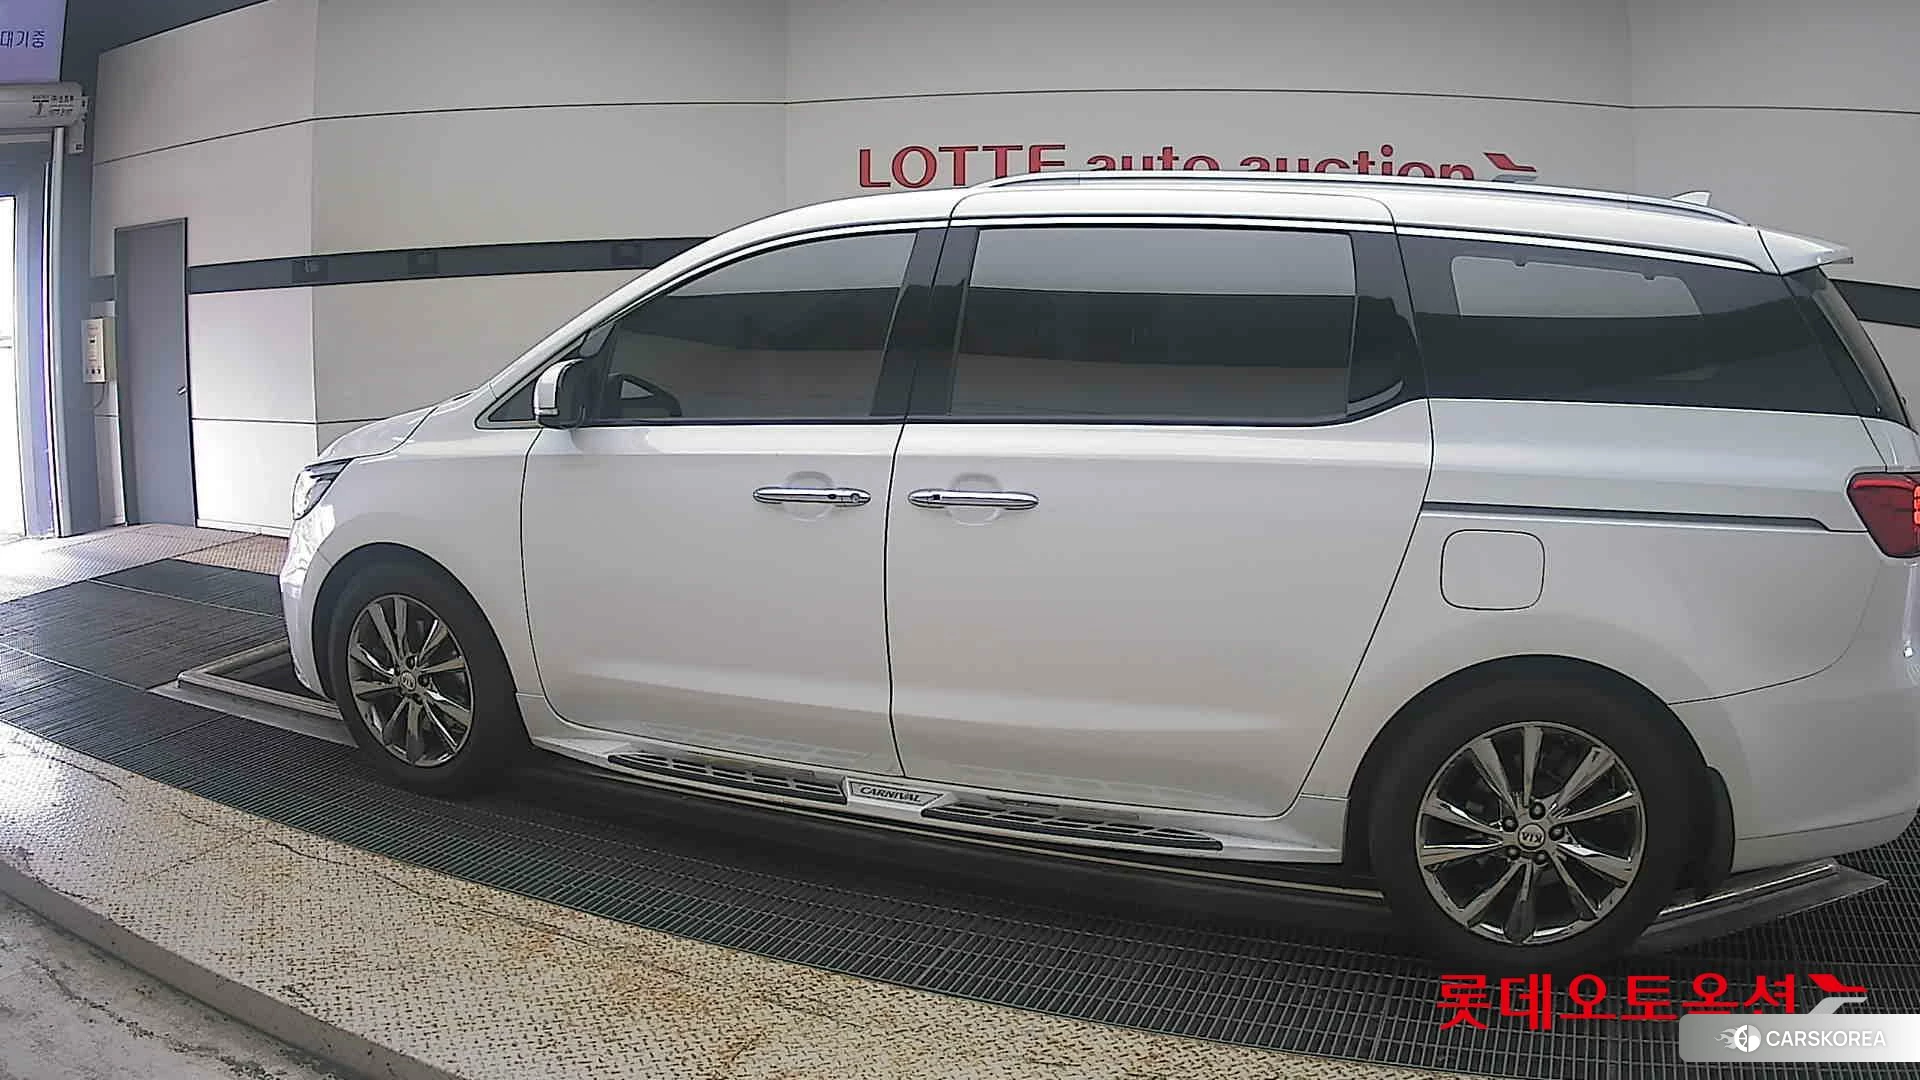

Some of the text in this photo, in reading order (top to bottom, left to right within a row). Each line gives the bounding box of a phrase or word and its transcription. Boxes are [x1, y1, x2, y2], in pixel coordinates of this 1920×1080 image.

[0, 30, 45, 48] 대기중
[859, 144, 1066, 189] LOTTE
[860, 787, 920, 802] CARNIVAL
